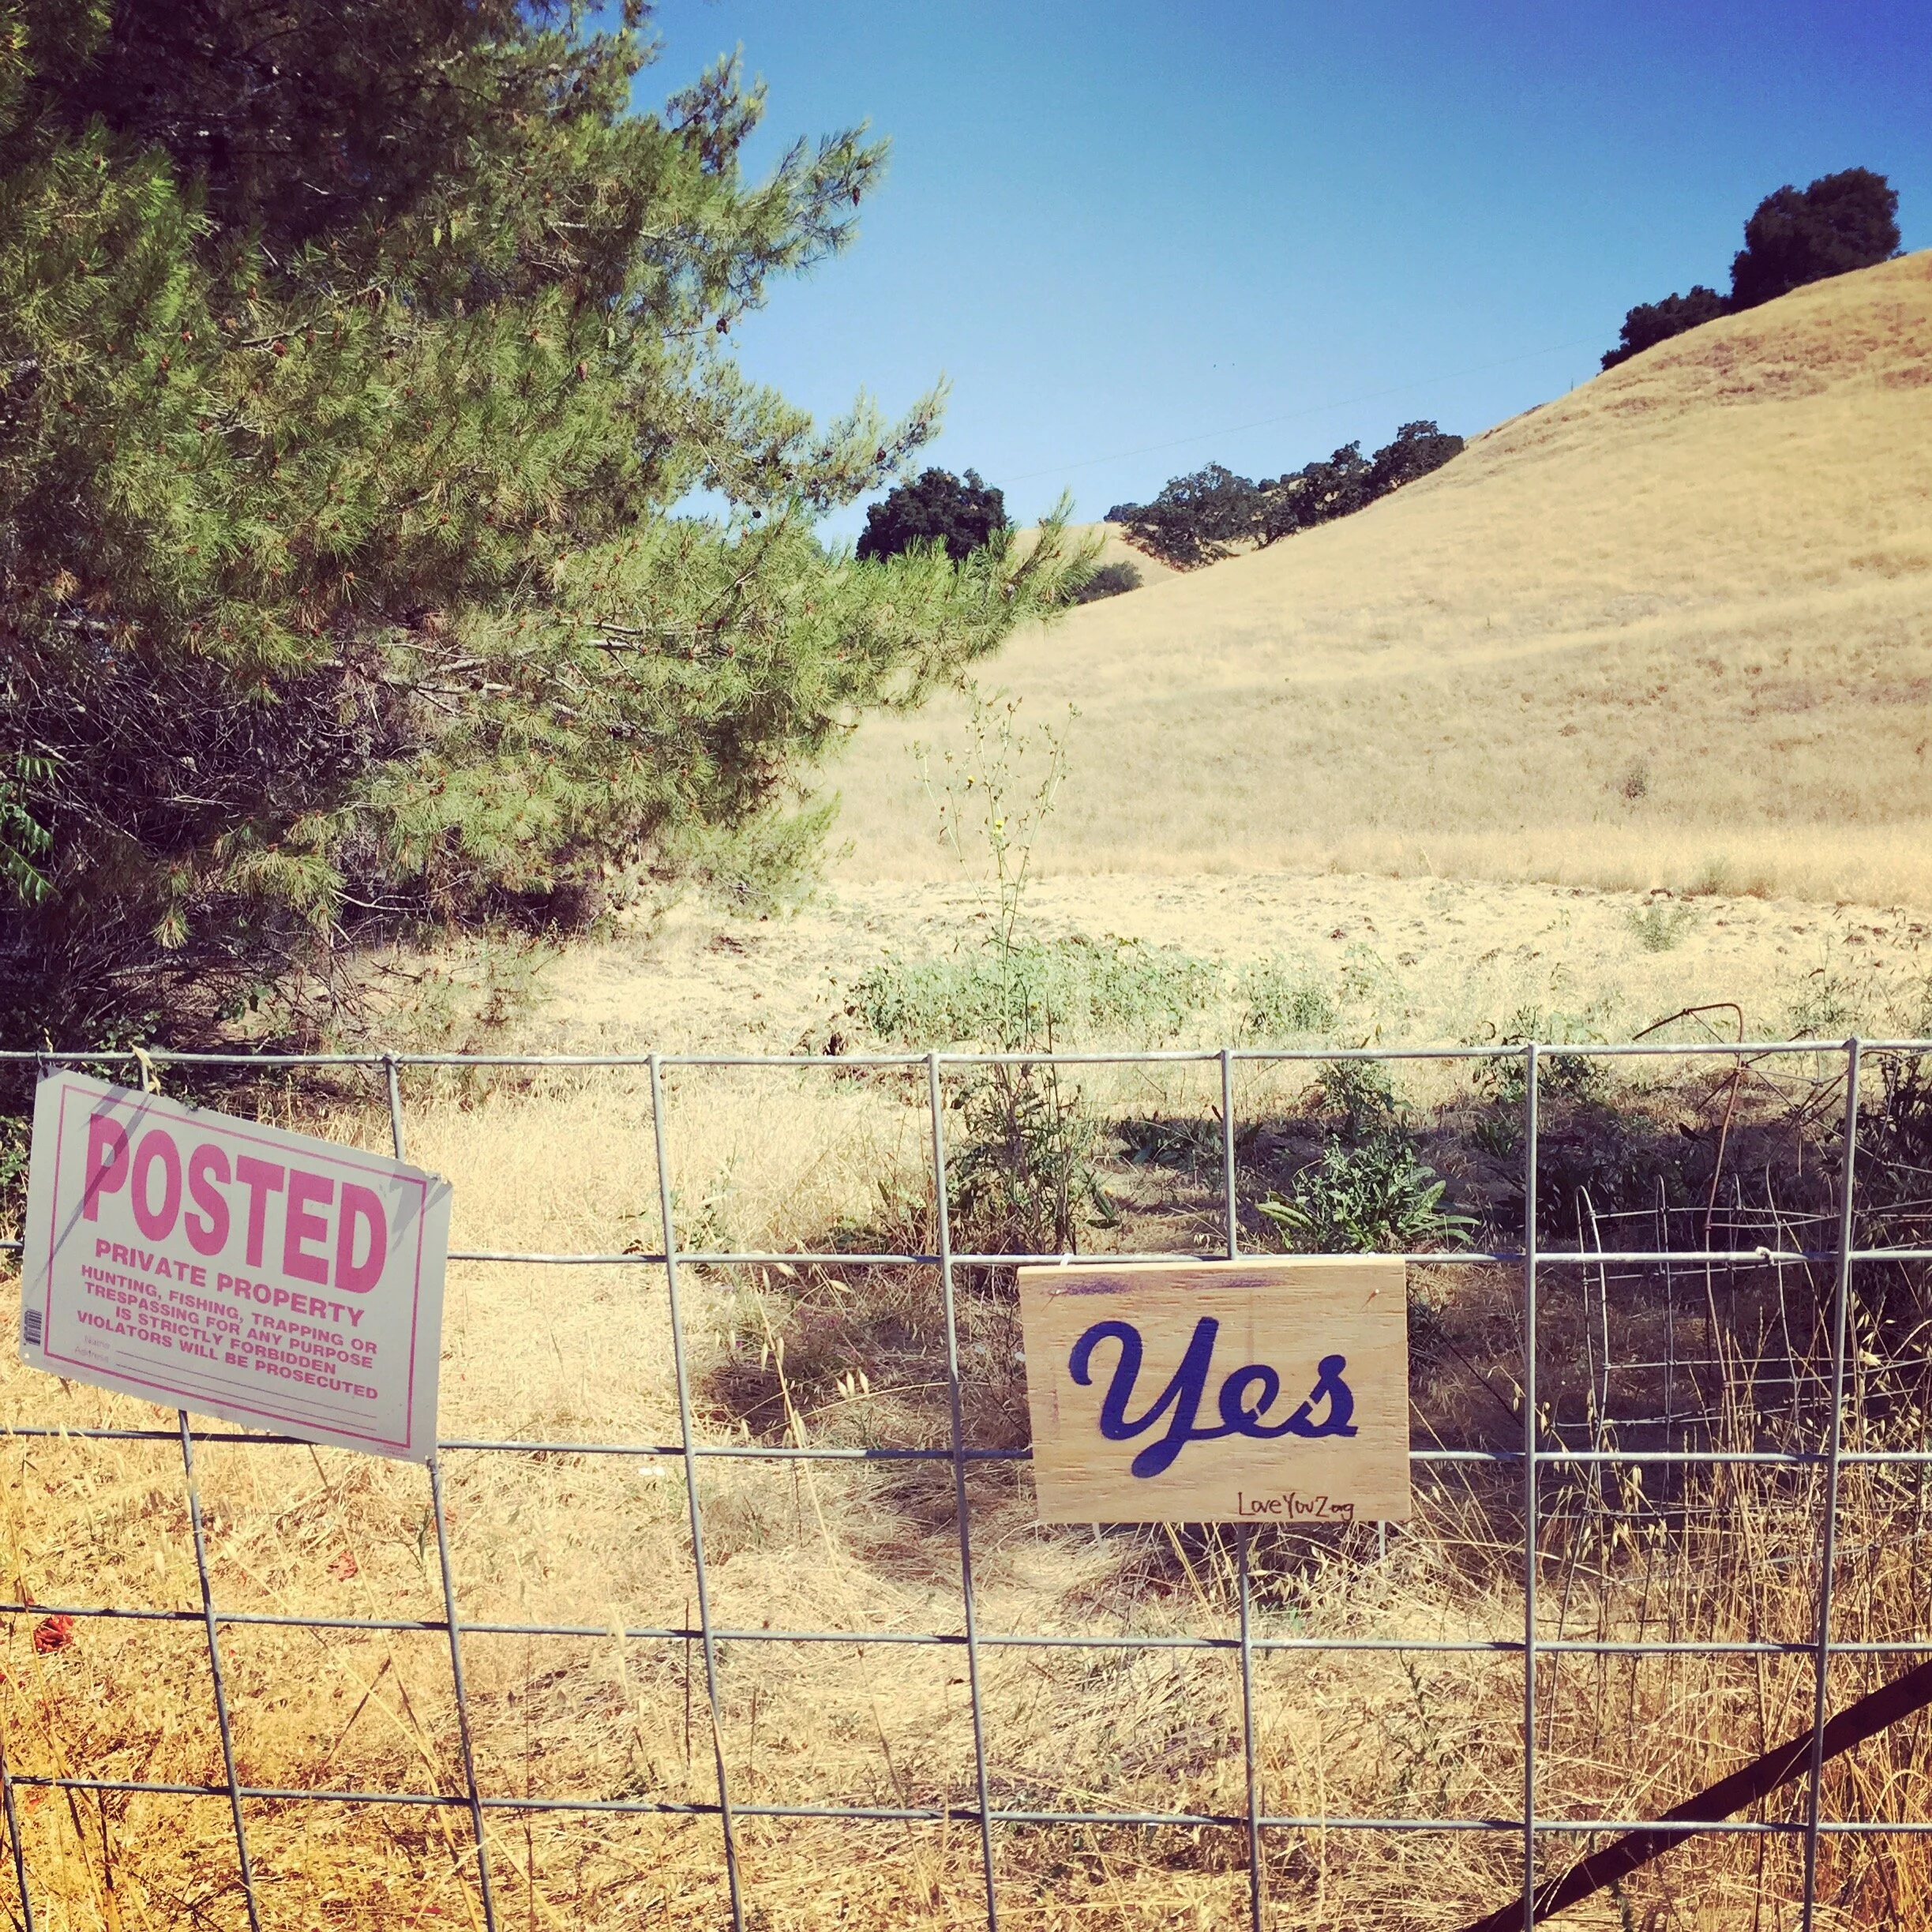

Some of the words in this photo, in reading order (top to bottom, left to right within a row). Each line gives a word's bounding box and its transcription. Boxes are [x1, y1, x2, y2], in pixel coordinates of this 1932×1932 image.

[83, 1113, 387, 1294] POSTED
[81, 1264, 162, 1301] HUNTING,
[169, 1289, 244, 1324] FISHING,
[251, 1312, 344, 1346] TRAPPING
[351, 1337, 377, 1355] OR
[84, 1281, 200, 1325] TRESPASSING
[206, 1316, 240, 1336] FOR
[246, 1327, 283, 1345] ANY
[289, 1337, 373, 1369] PURPOSE
[95, 1238, 207, 1288] PRIVATE
[216, 1272, 365, 1327] PROPERTY
[77, 1310, 173, 1349] VIOLATORS
[178, 1339, 219, 1360] WILL
[225, 1352, 249, 1368] BE
[254, 1360, 378, 1400] PROSECUTED
[115, 1306, 132, 1321] IS
[137, 1313, 223, 1345] STRICTLY
[230, 1338, 336, 1375] FORBIDDEN
[1068, 1316, 1358, 1479] Yes
